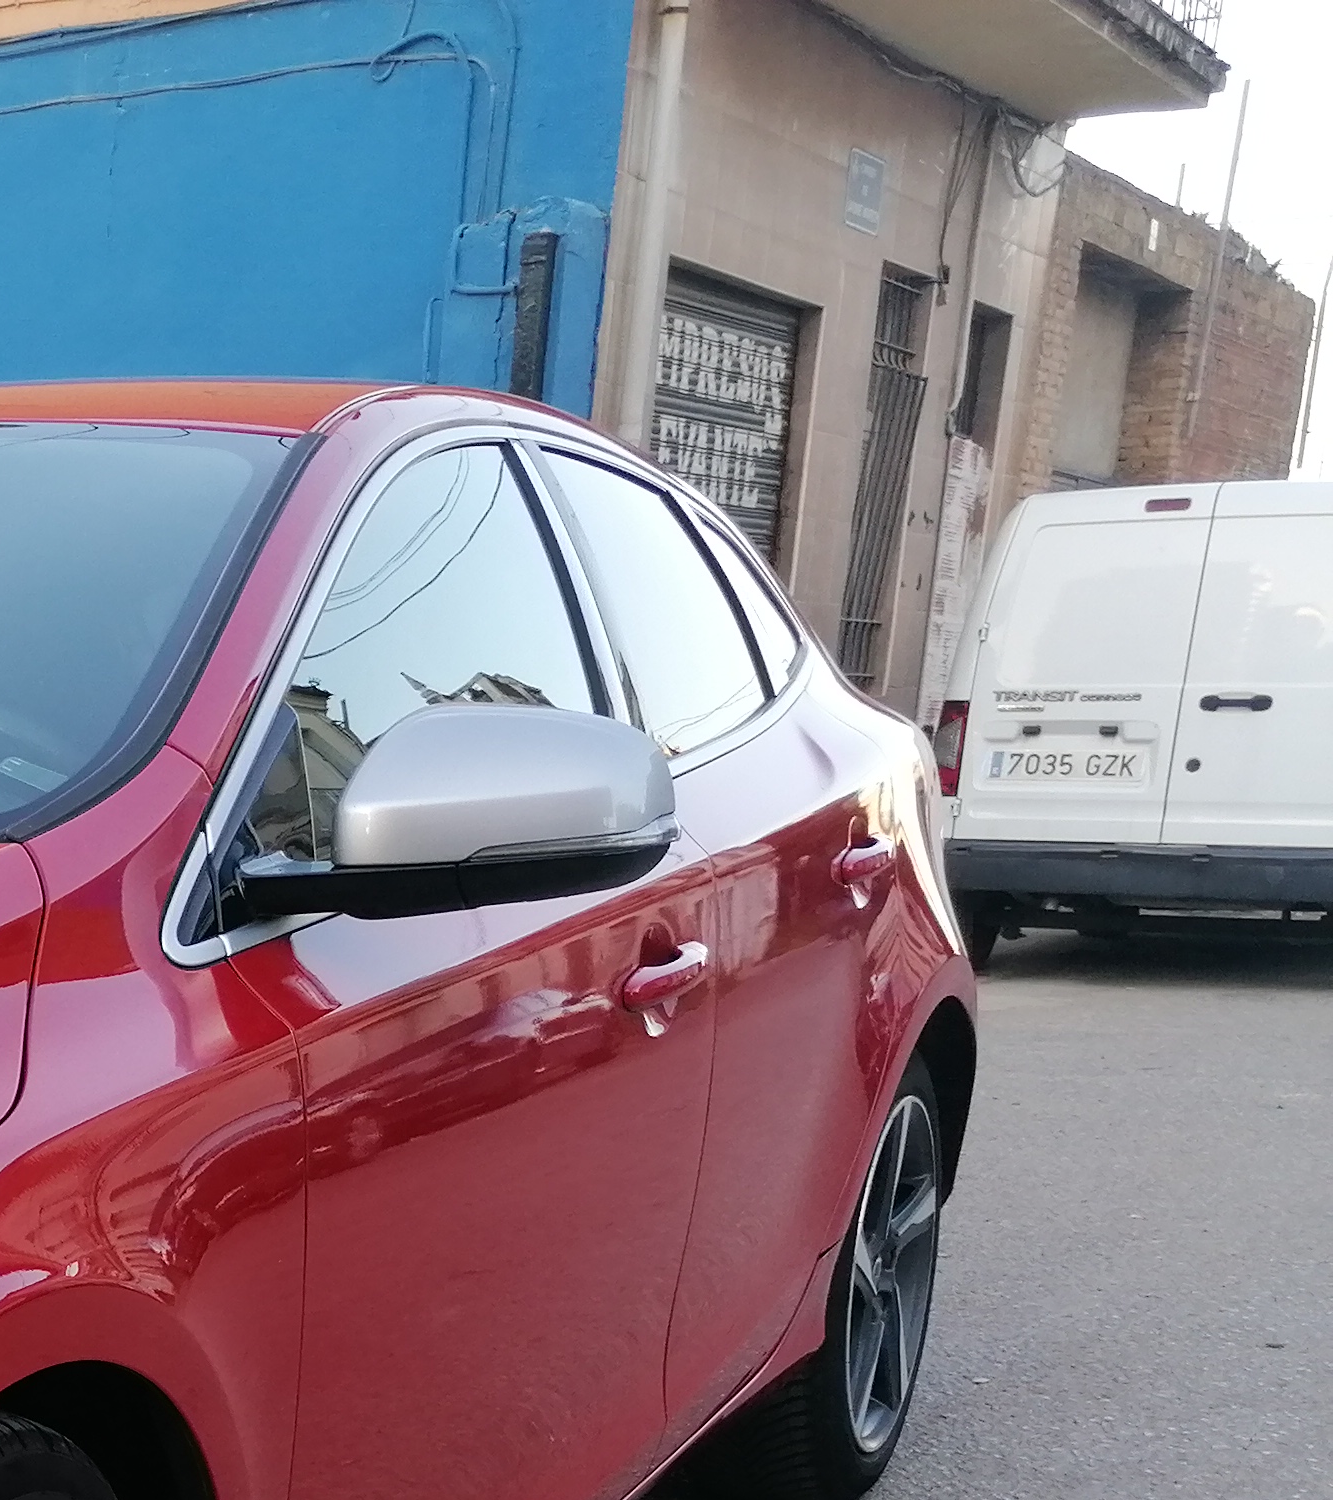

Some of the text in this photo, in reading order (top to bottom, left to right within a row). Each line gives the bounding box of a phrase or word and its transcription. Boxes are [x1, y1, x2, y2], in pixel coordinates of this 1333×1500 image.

[993, 690, 1079, 702] TRANSIT
[1006, 753, 1136, 777] 7035 GZK
